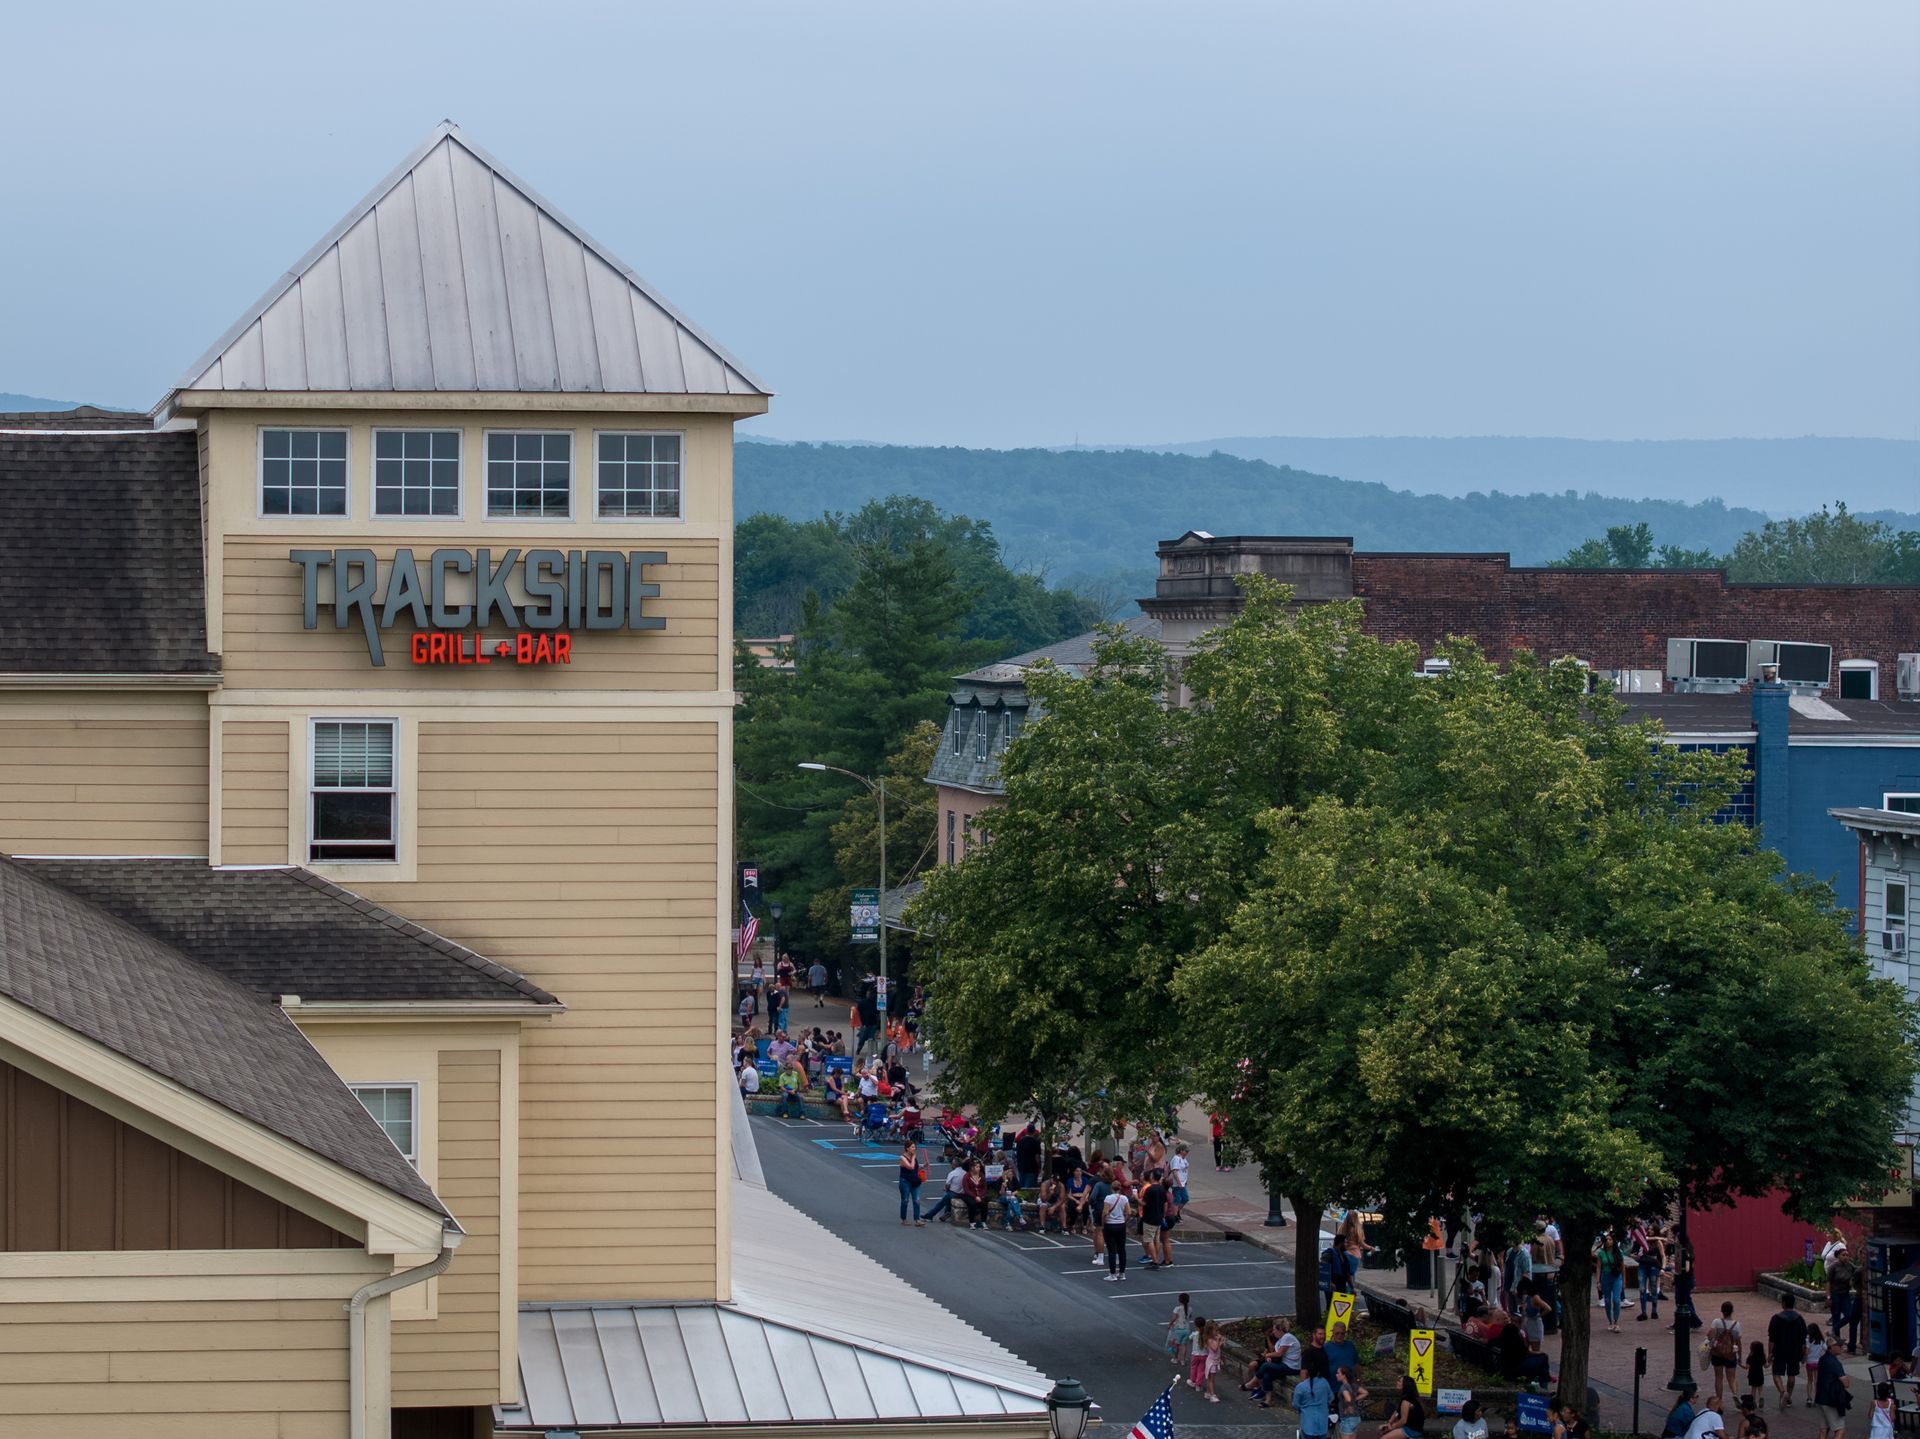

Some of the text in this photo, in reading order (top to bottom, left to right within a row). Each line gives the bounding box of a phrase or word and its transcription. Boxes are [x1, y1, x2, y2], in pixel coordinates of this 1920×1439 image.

[289, 548, 668, 667] TRACKSIDE
[411, 632, 491, 665] GRILL
[516, 633, 572, 665] BAR
